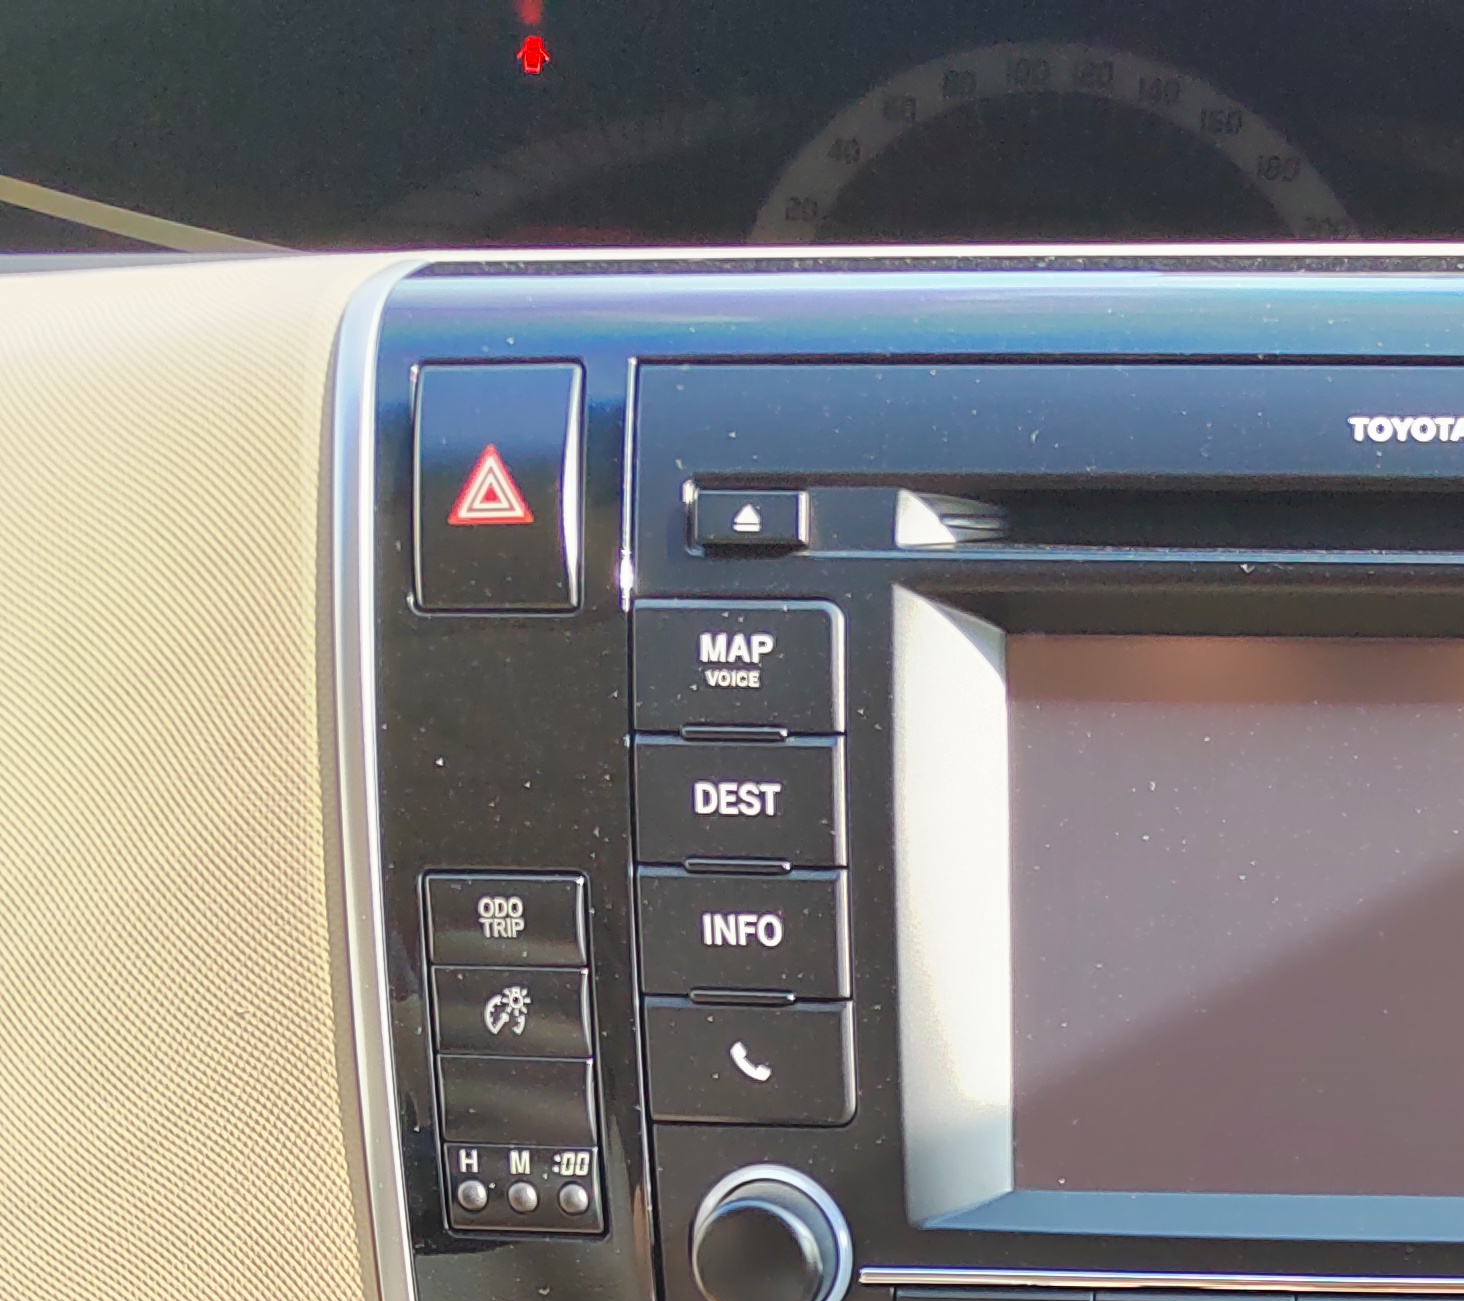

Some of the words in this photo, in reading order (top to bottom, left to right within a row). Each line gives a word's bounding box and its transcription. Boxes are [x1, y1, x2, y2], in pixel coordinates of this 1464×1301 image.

[699, 632, 774, 664] MAP
[704, 669, 760, 688] VOICE
[694, 781, 782, 816] DEST
[477, 896, 524, 918] ODO
[479, 917, 525, 939] TRIP
[702, 913, 783, 947] INFO
[459, 1148, 479, 1173] H
[509, 1150, 531, 1175] M
